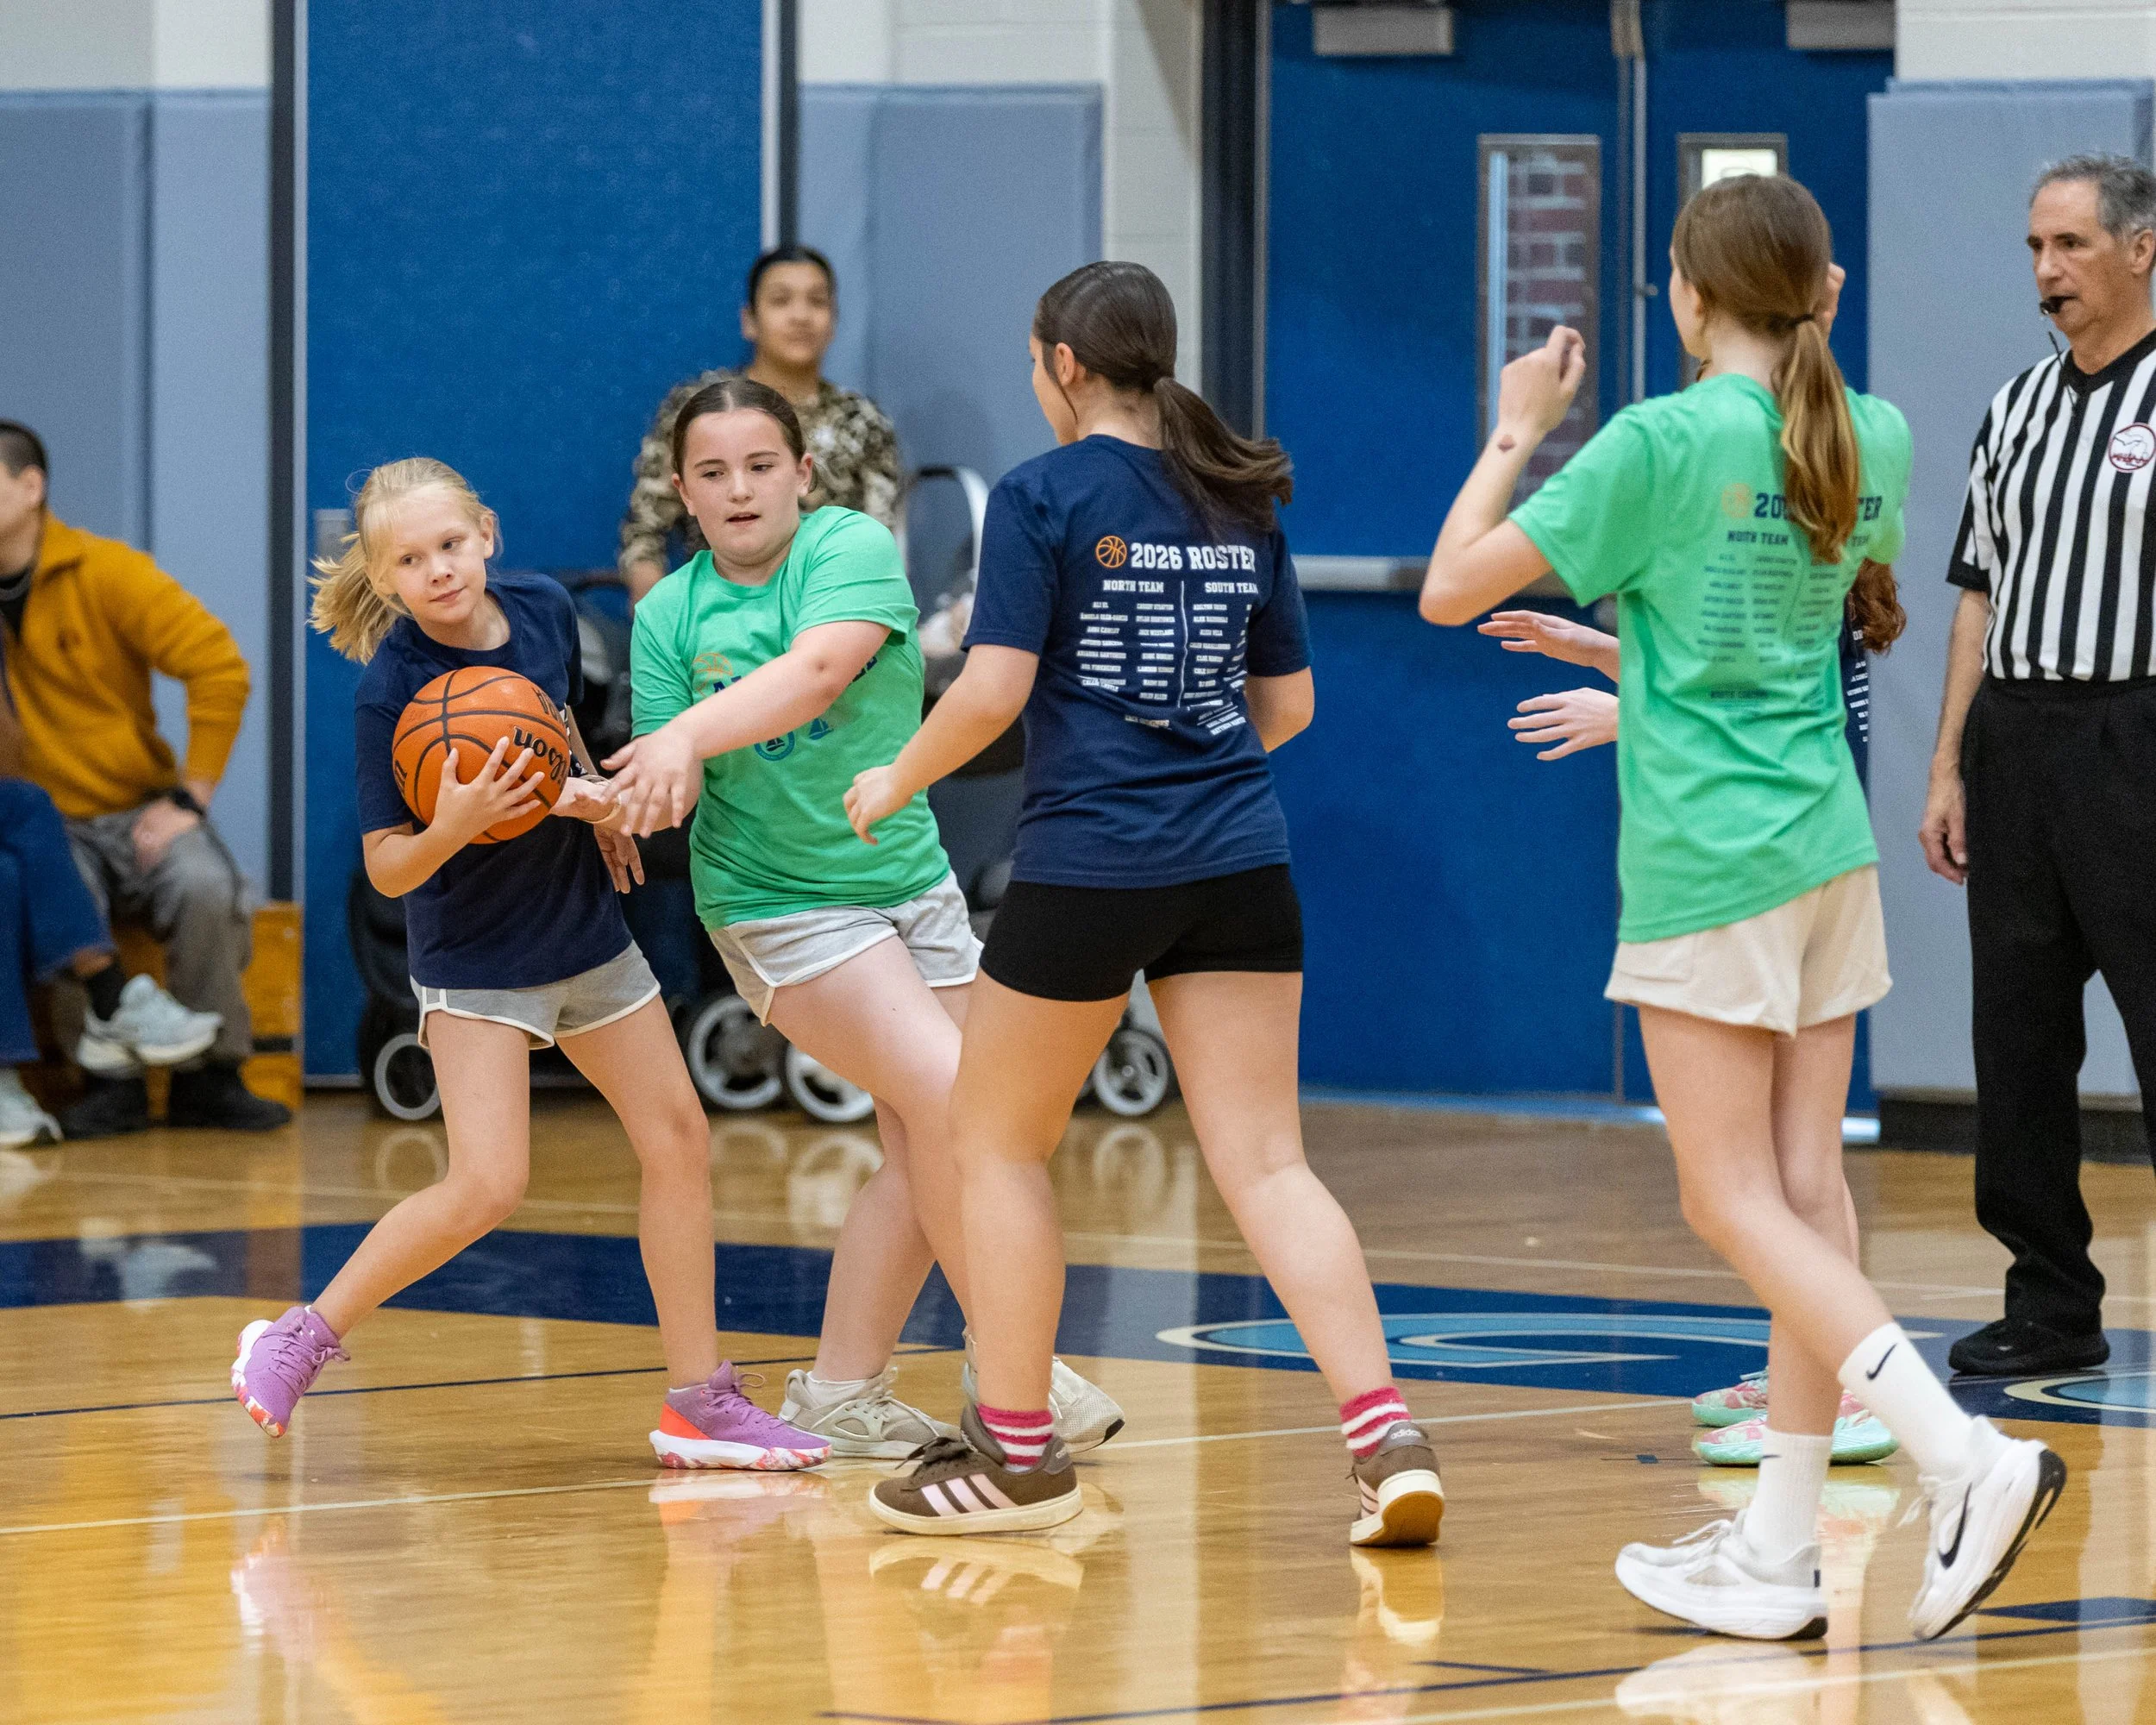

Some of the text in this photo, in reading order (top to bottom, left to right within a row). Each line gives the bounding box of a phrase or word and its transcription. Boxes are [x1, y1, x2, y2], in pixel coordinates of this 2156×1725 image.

[1131, 543, 1256, 572] 2026 ROSTER
[1103, 580, 1164, 593] NORTH TEAM
[1205, 581, 1235, 593] SOUTH
